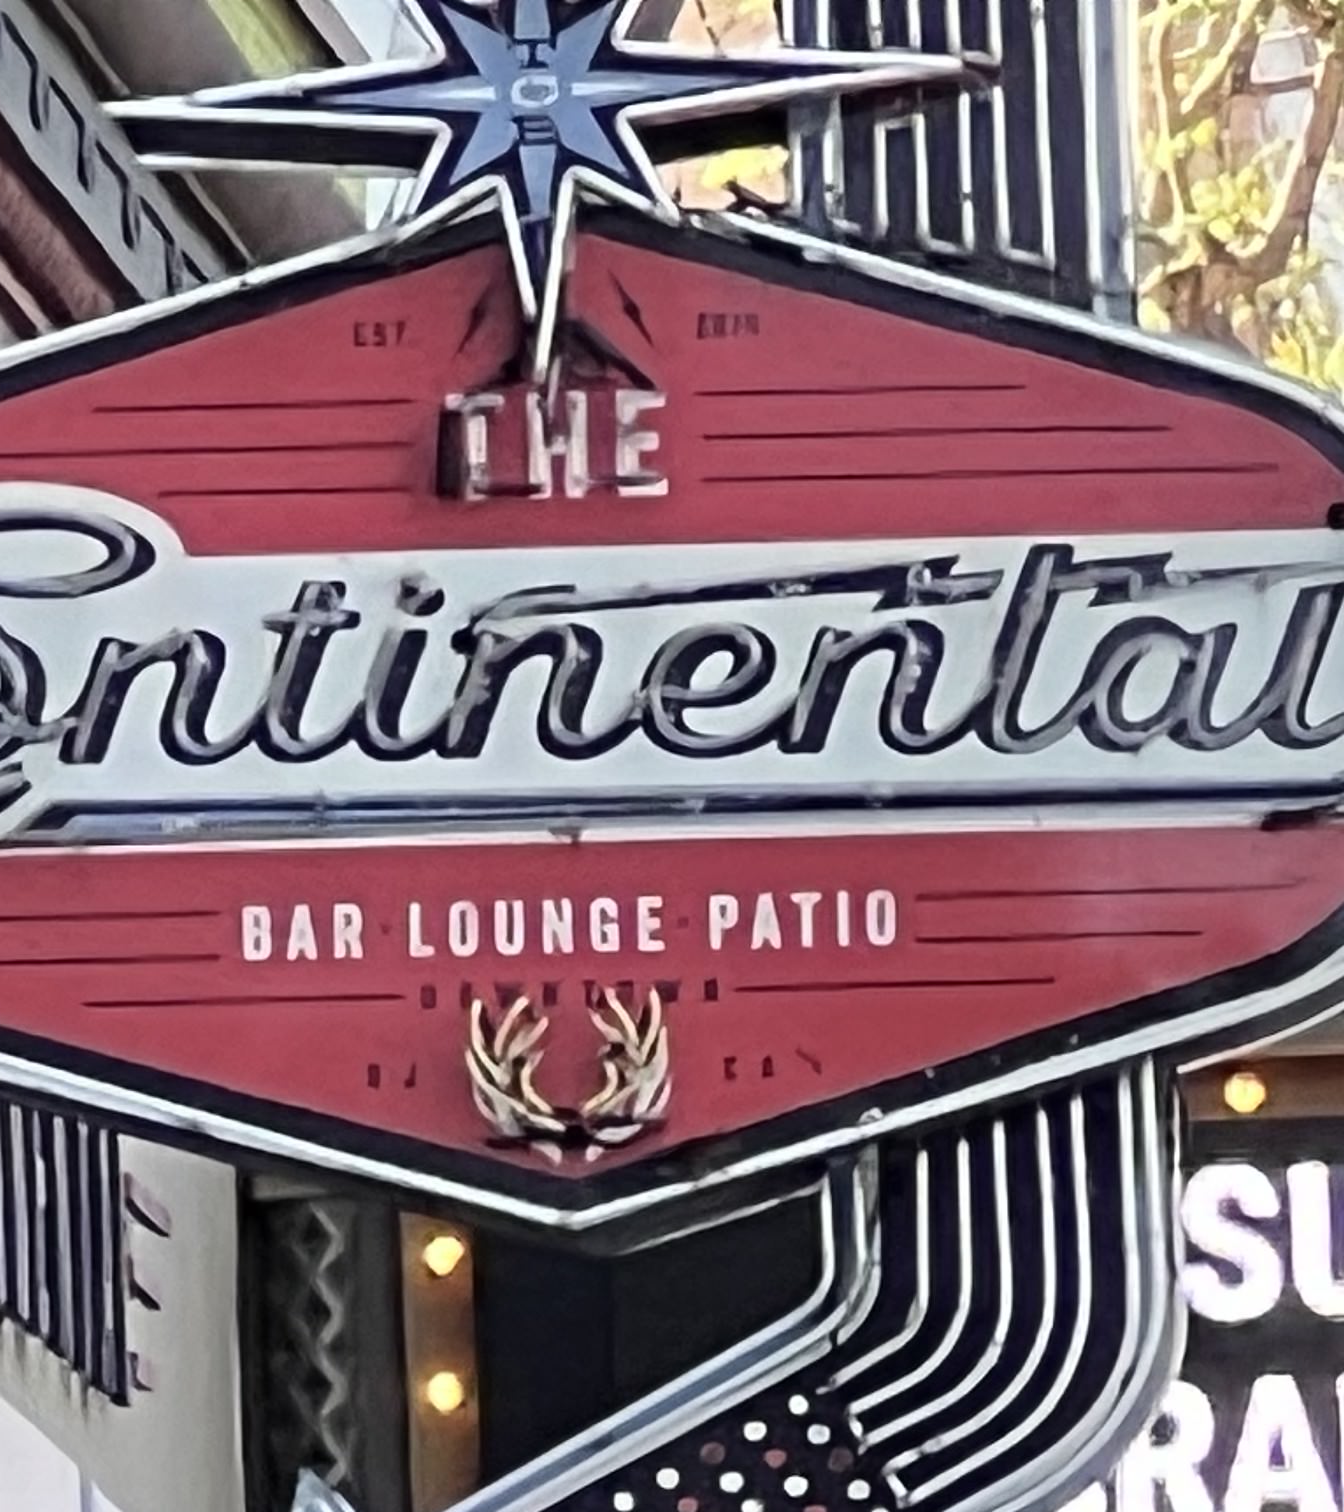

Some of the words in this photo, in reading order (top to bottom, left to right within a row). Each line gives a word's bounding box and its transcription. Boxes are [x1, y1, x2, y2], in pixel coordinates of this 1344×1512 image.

[445, 388, 670, 501] THE
[240, 904, 365, 961] BAR
[407, 895, 666, 958] LOUNGE
[708, 889, 898, 952] PATIO
